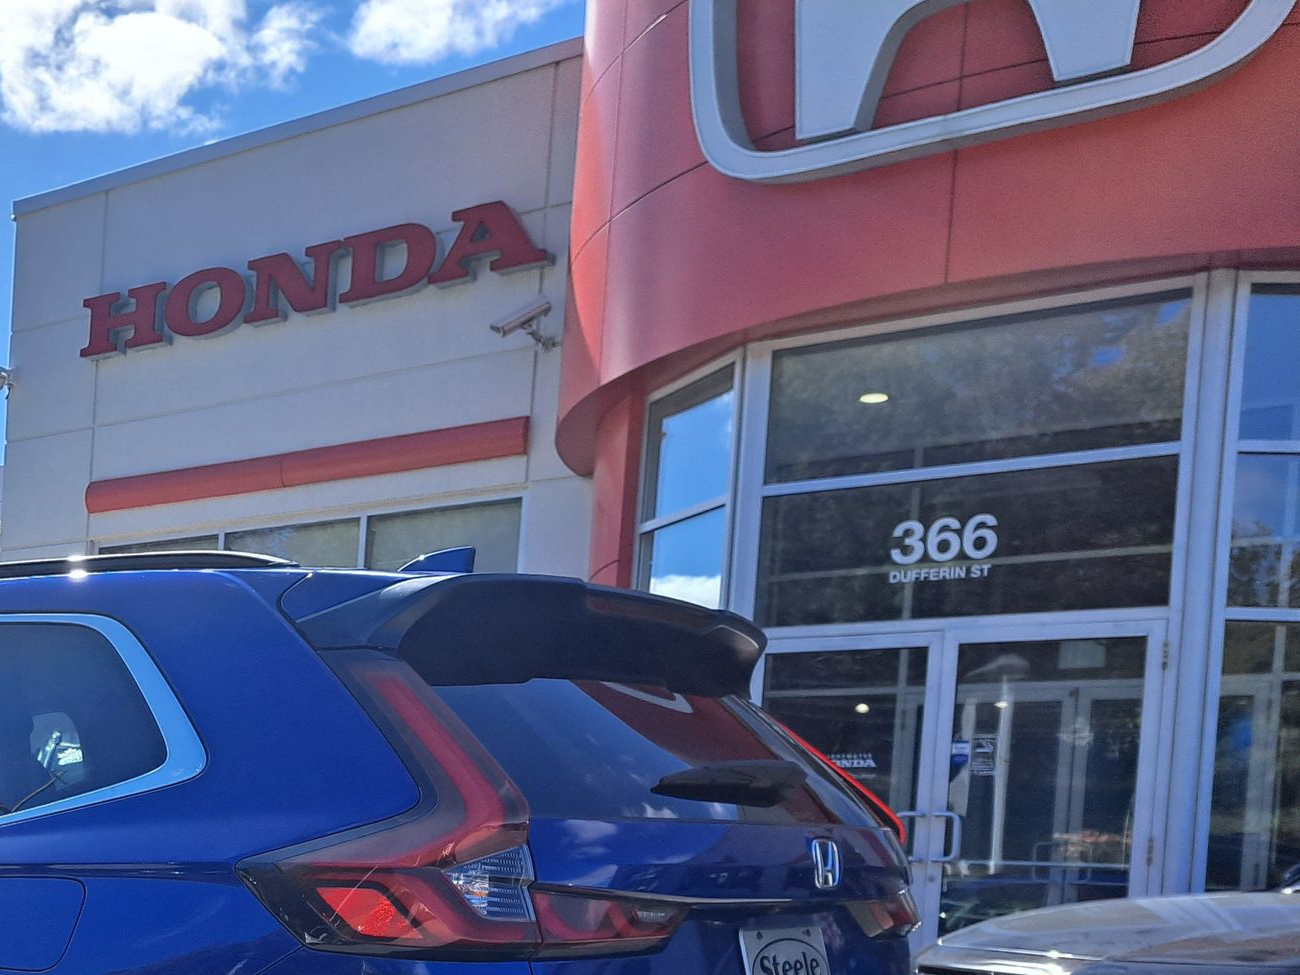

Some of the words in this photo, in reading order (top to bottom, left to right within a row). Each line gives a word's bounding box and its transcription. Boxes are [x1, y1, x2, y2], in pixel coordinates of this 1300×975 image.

[79, 200, 551, 359] HONDA
[890, 512, 999, 565] 366
[889, 566, 966, 584] DUFFERIN
[971, 563, 992, 578] ST
